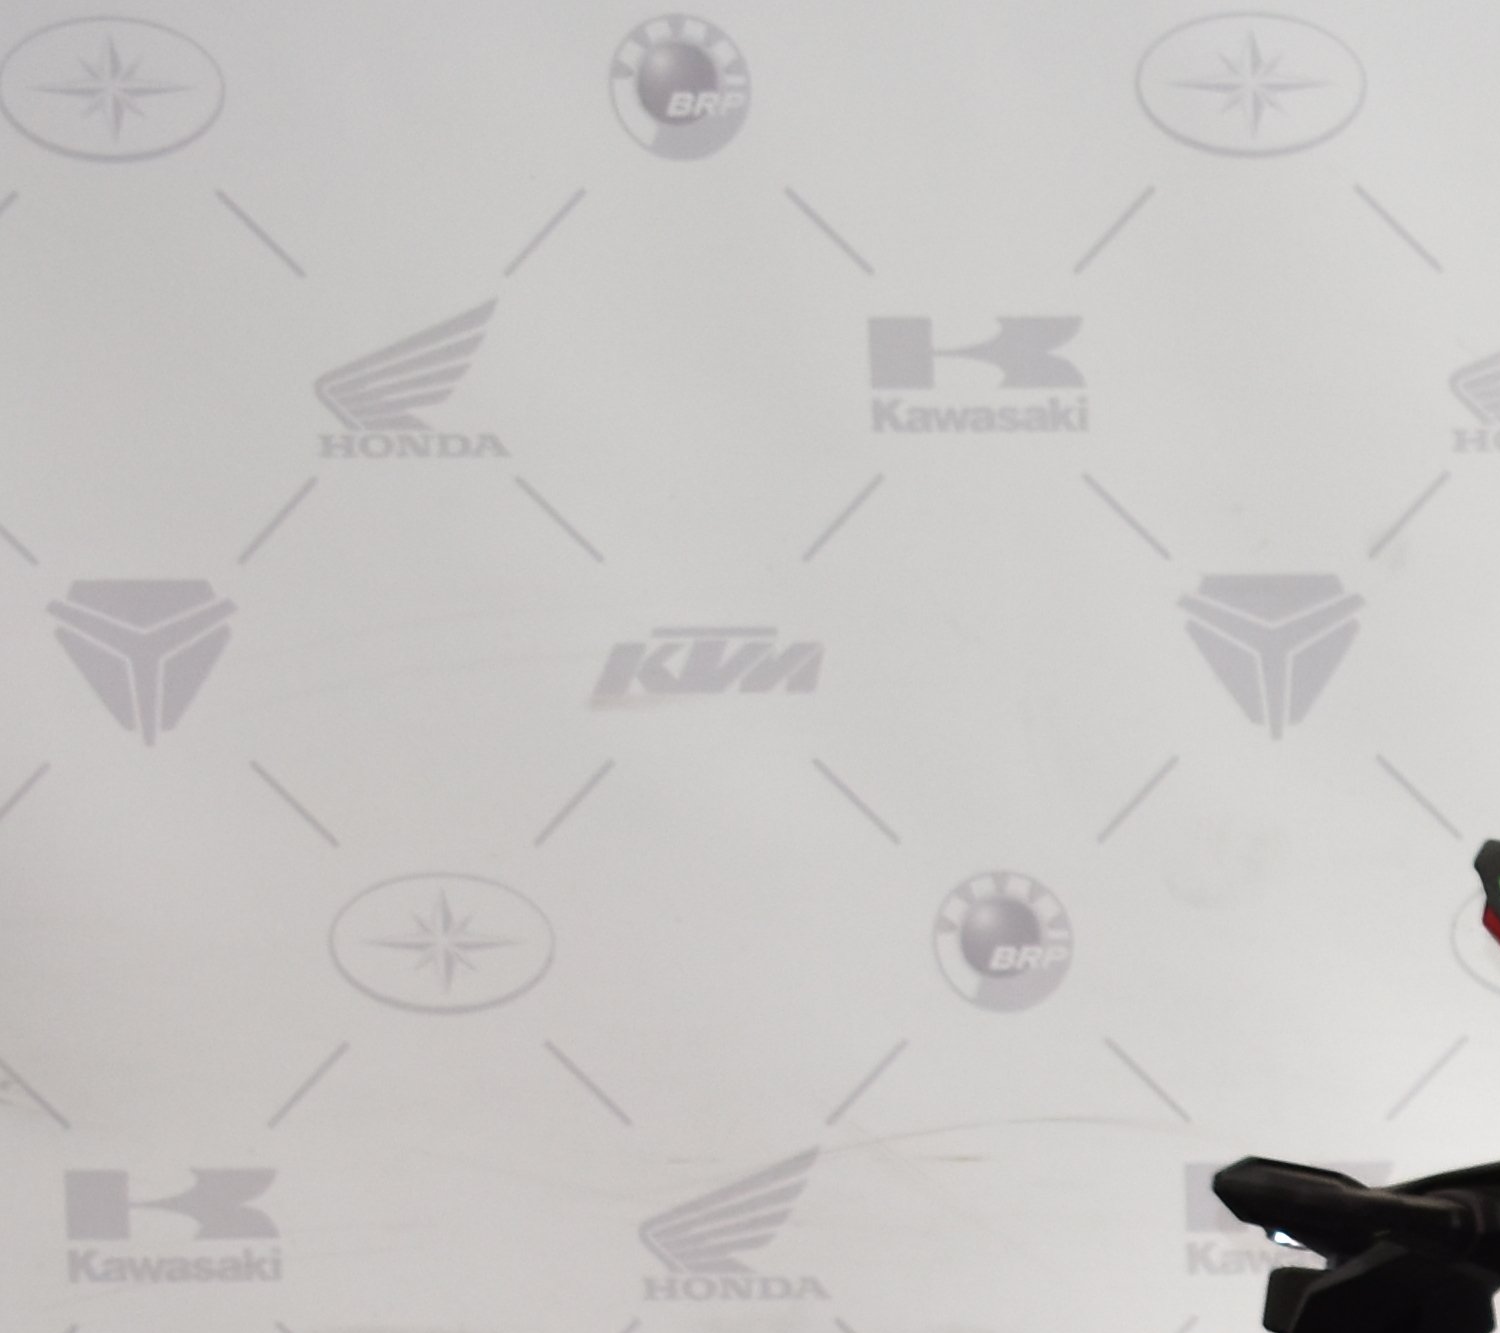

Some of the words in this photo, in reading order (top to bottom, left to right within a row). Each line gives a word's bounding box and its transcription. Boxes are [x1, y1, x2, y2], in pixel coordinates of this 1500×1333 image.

[667, 92, 745, 117] BRP
[871, 397, 1088, 434] Kawasaki
[318, 433, 510, 458] HONDA
[590, 627, 823, 695] KTM
[991, 946, 1069, 972] BRP
[67, 1249, 282, 1283] Kawasaki
[642, 1276, 830, 1301] HONDA
